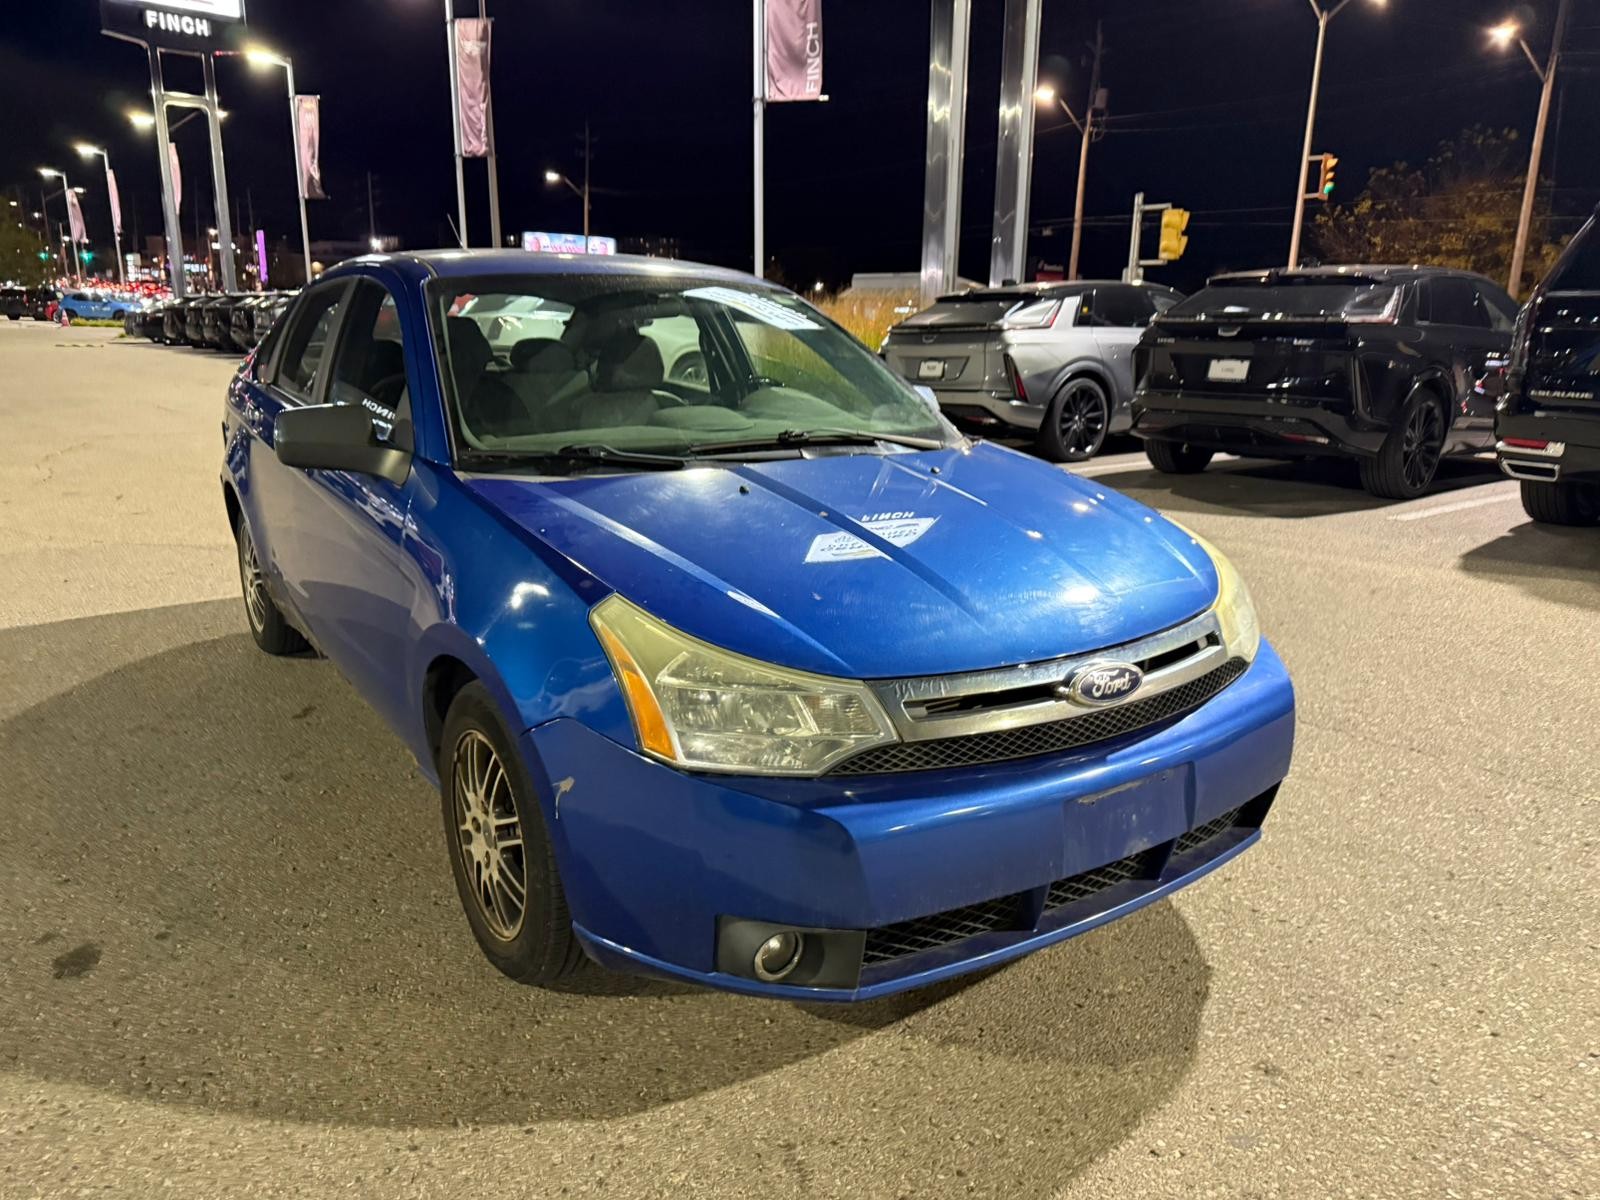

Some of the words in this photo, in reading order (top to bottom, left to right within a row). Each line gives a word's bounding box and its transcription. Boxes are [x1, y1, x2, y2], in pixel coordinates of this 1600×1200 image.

[145, 9, 212, 37] FINCH
[806, 22, 820, 93] FINCH
[1090, 669, 1136, 698] Ford
